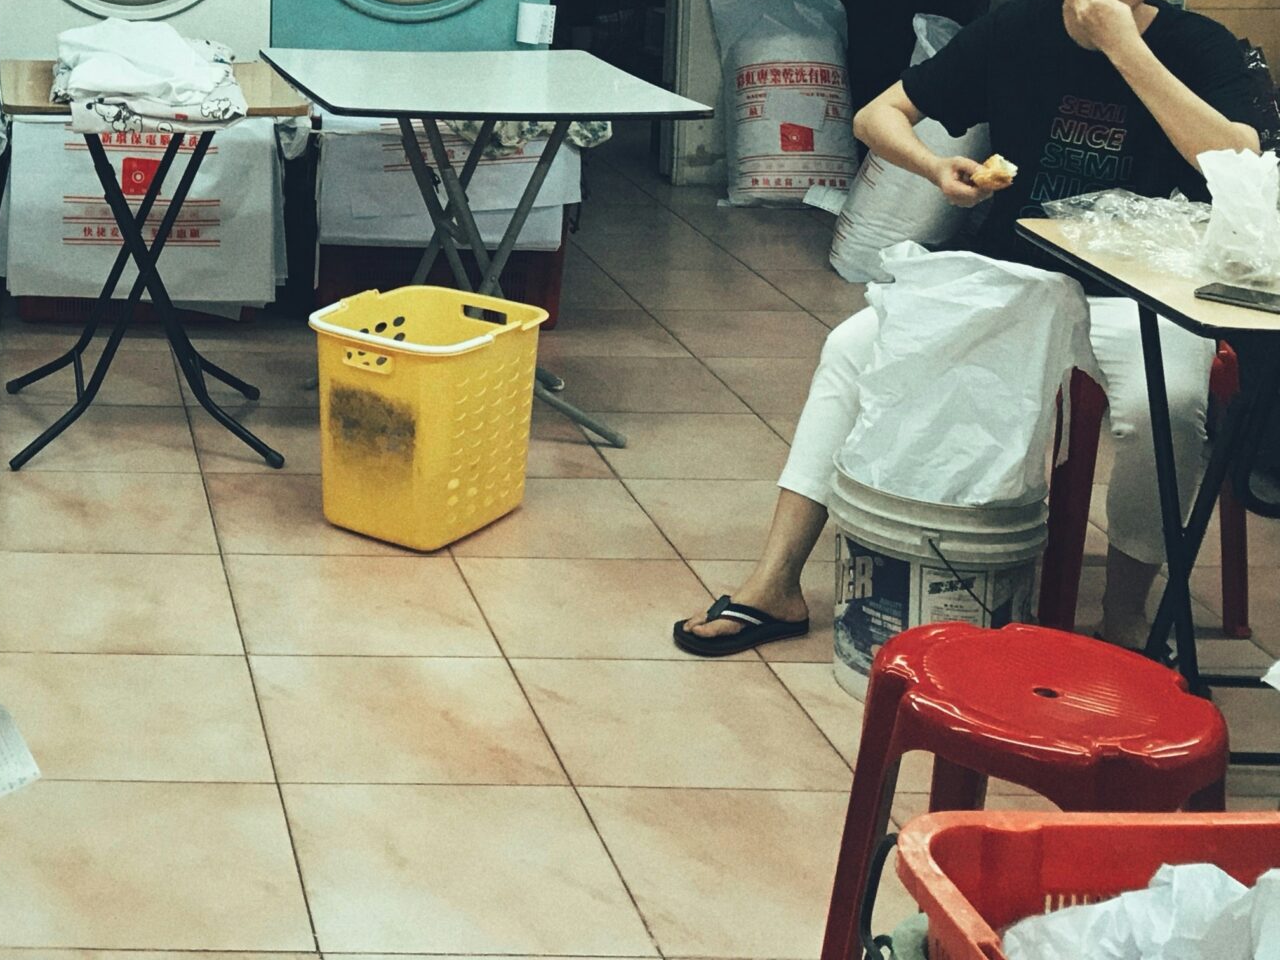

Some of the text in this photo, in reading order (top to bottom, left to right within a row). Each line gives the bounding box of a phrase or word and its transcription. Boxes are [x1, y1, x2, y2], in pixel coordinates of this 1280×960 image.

[1058, 94, 1129, 124] SEMI
[1050, 116, 1128, 152] NICE
[1039, 142, 1134, 182] SEMI
